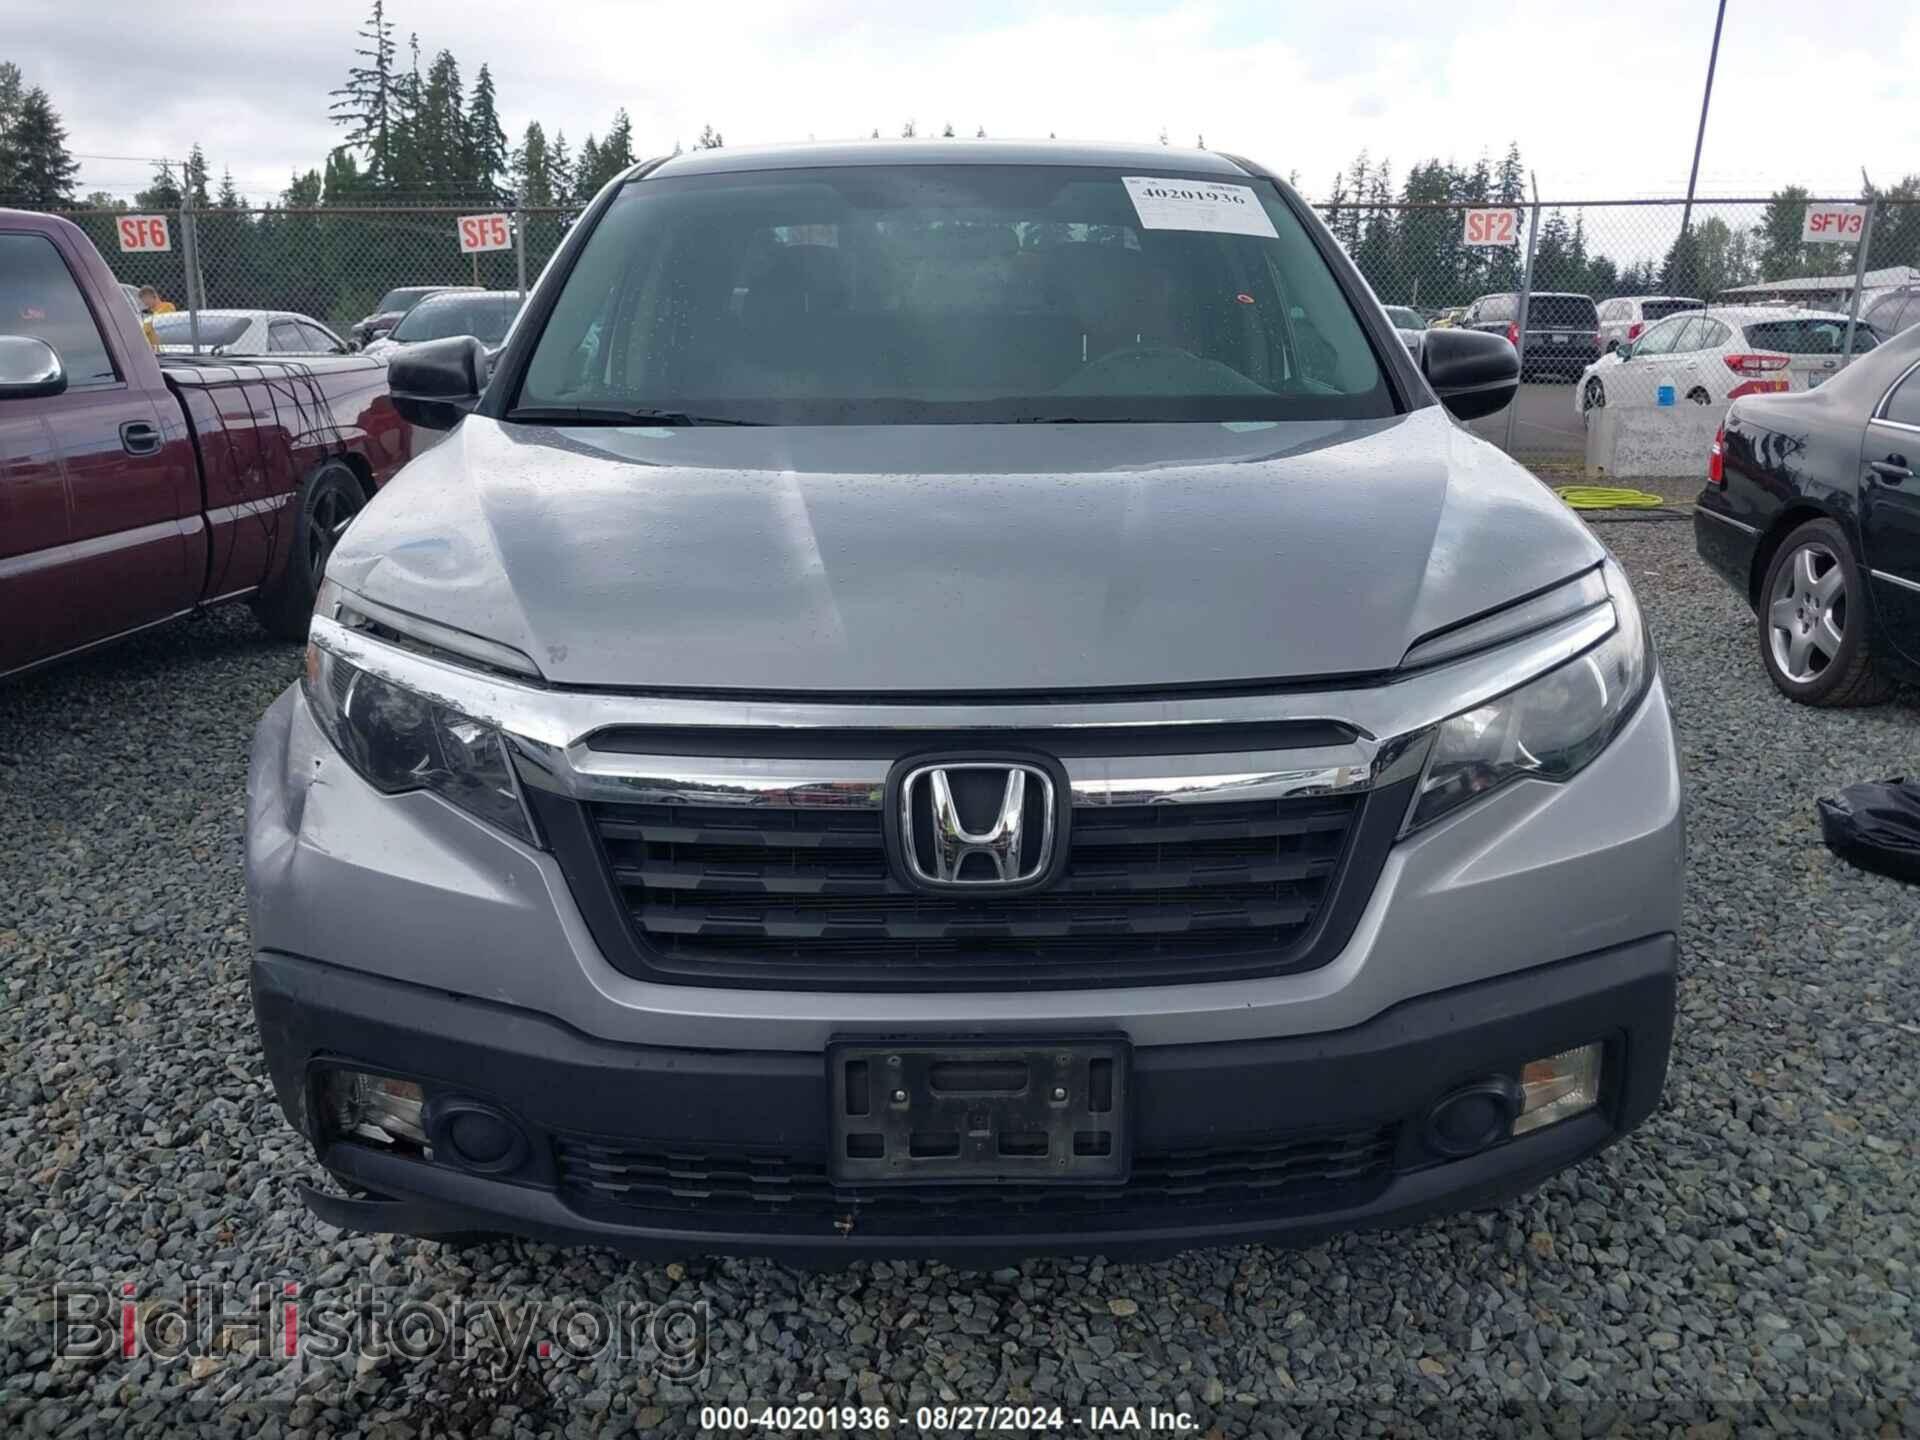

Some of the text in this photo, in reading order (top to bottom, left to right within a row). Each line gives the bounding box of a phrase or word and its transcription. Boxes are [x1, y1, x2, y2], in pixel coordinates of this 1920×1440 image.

[1143, 187, 1246, 205] 40201936
[121, 219, 166, 248] SF6
[462, 217, 507, 248] SF5
[1468, 212, 1513, 241] SF2
[1809, 212, 1863, 233] SFV3
